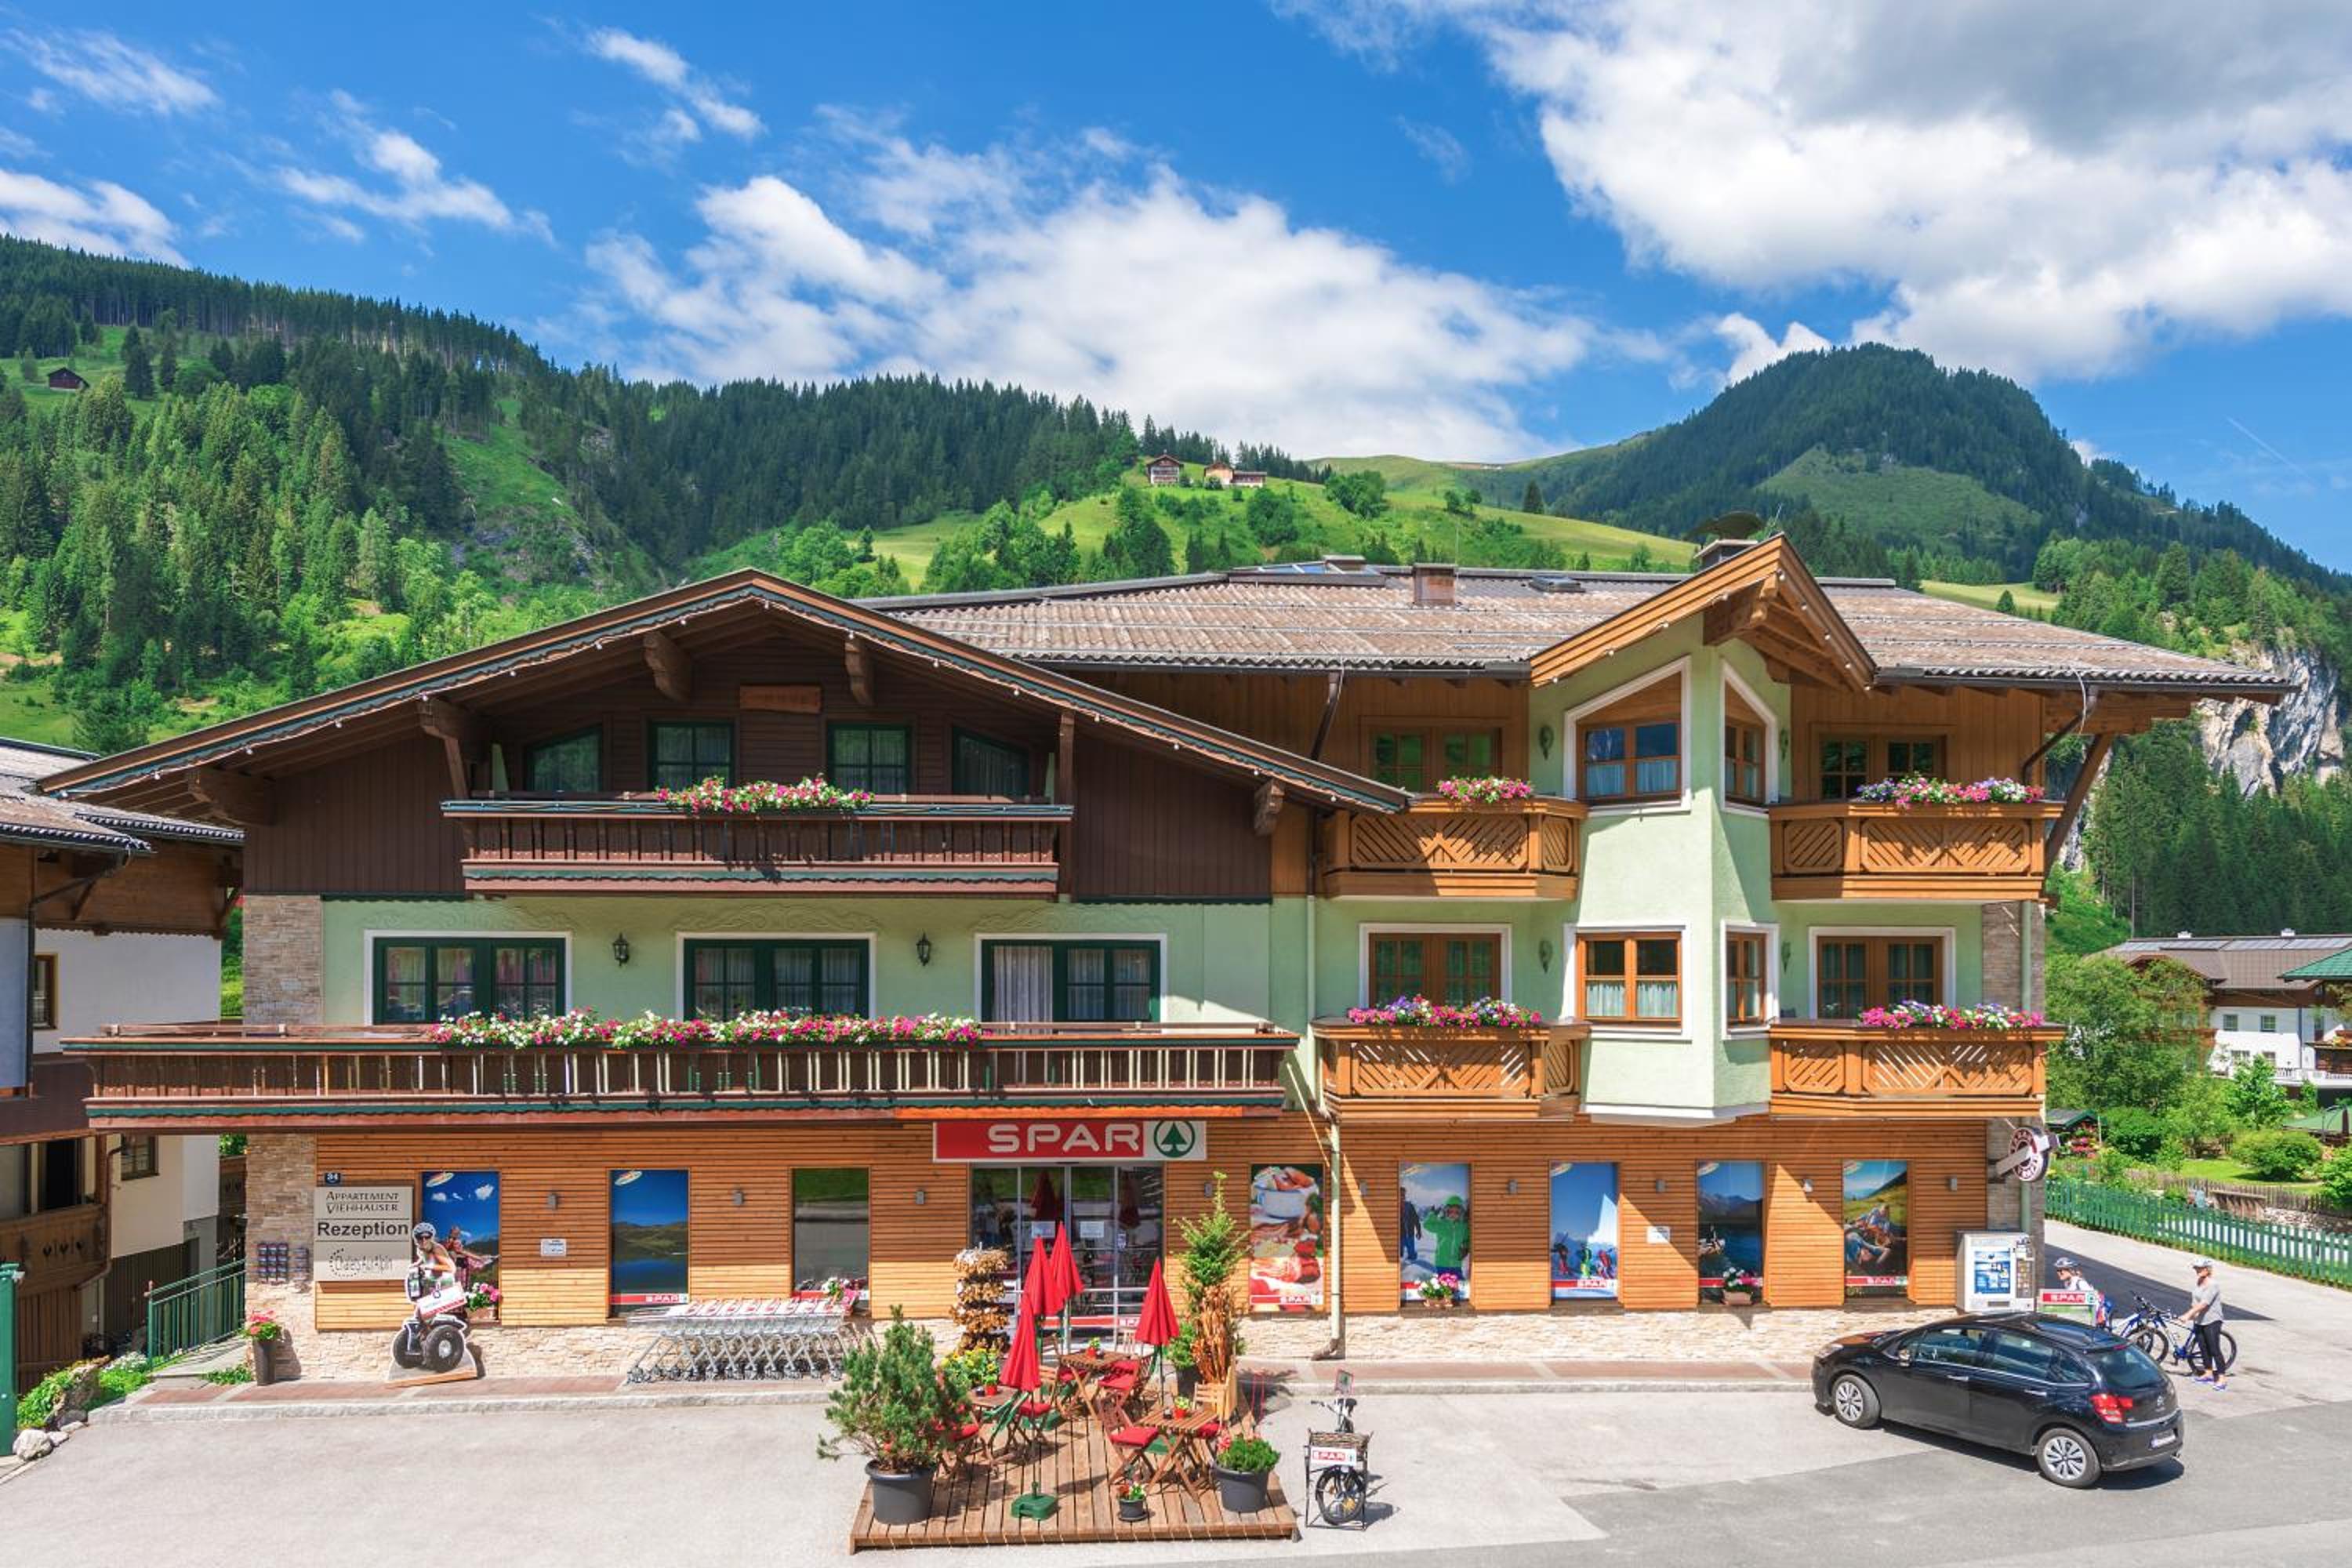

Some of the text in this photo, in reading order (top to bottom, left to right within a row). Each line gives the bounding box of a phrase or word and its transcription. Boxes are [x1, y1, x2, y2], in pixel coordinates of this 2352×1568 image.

[988, 1123, 1139, 1152] SPAR
[326, 1191, 399, 1201] APPARTEMENT
[327, 1203, 398, 1214] VIEHHAUSER
[318, 1221, 409, 1239] Rezeption
[1312, 1451, 1345, 1461] SPAR
